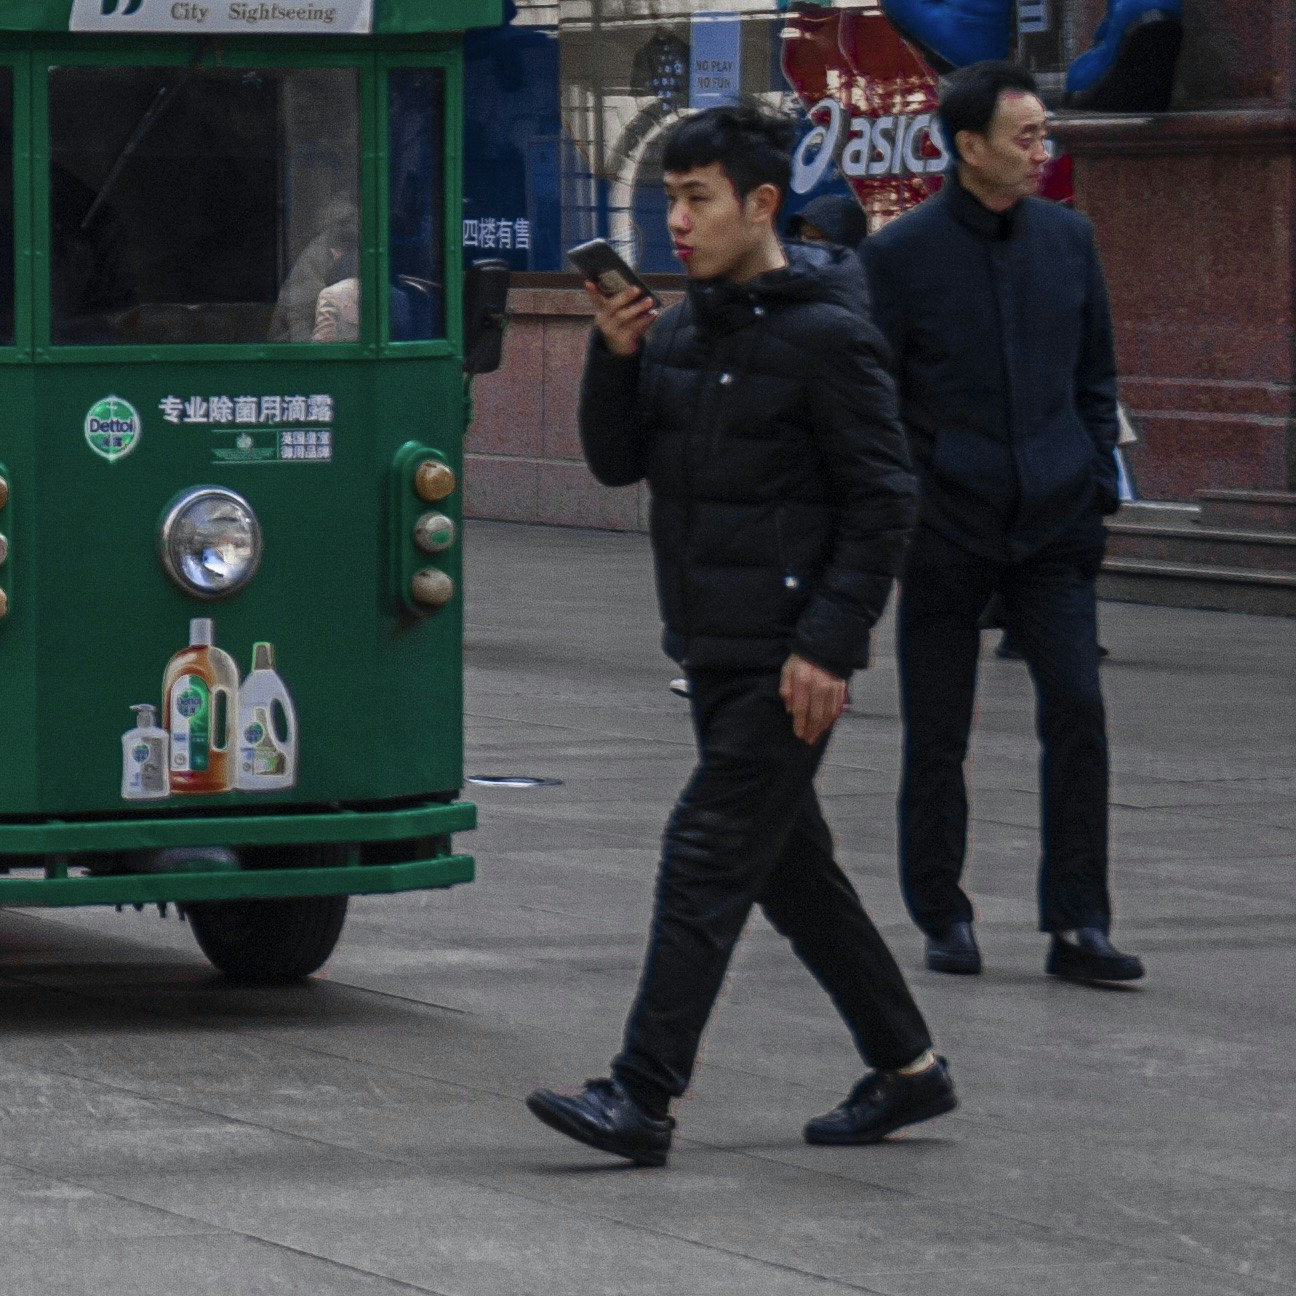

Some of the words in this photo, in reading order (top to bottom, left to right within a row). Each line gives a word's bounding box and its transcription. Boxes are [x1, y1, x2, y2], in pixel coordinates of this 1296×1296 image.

[170, 1, 209, 22] City
[228, 1, 337, 24] Sightseeing
[696, 60, 709, 72] NO
[711, 60, 734, 73] PLAY
[841, 113, 951, 177] asics
[463, 217, 530, 249] 四楼有售
[159, 393, 334, 423] 专业除菌用滴露
[89, 417, 134, 433] Dettol
